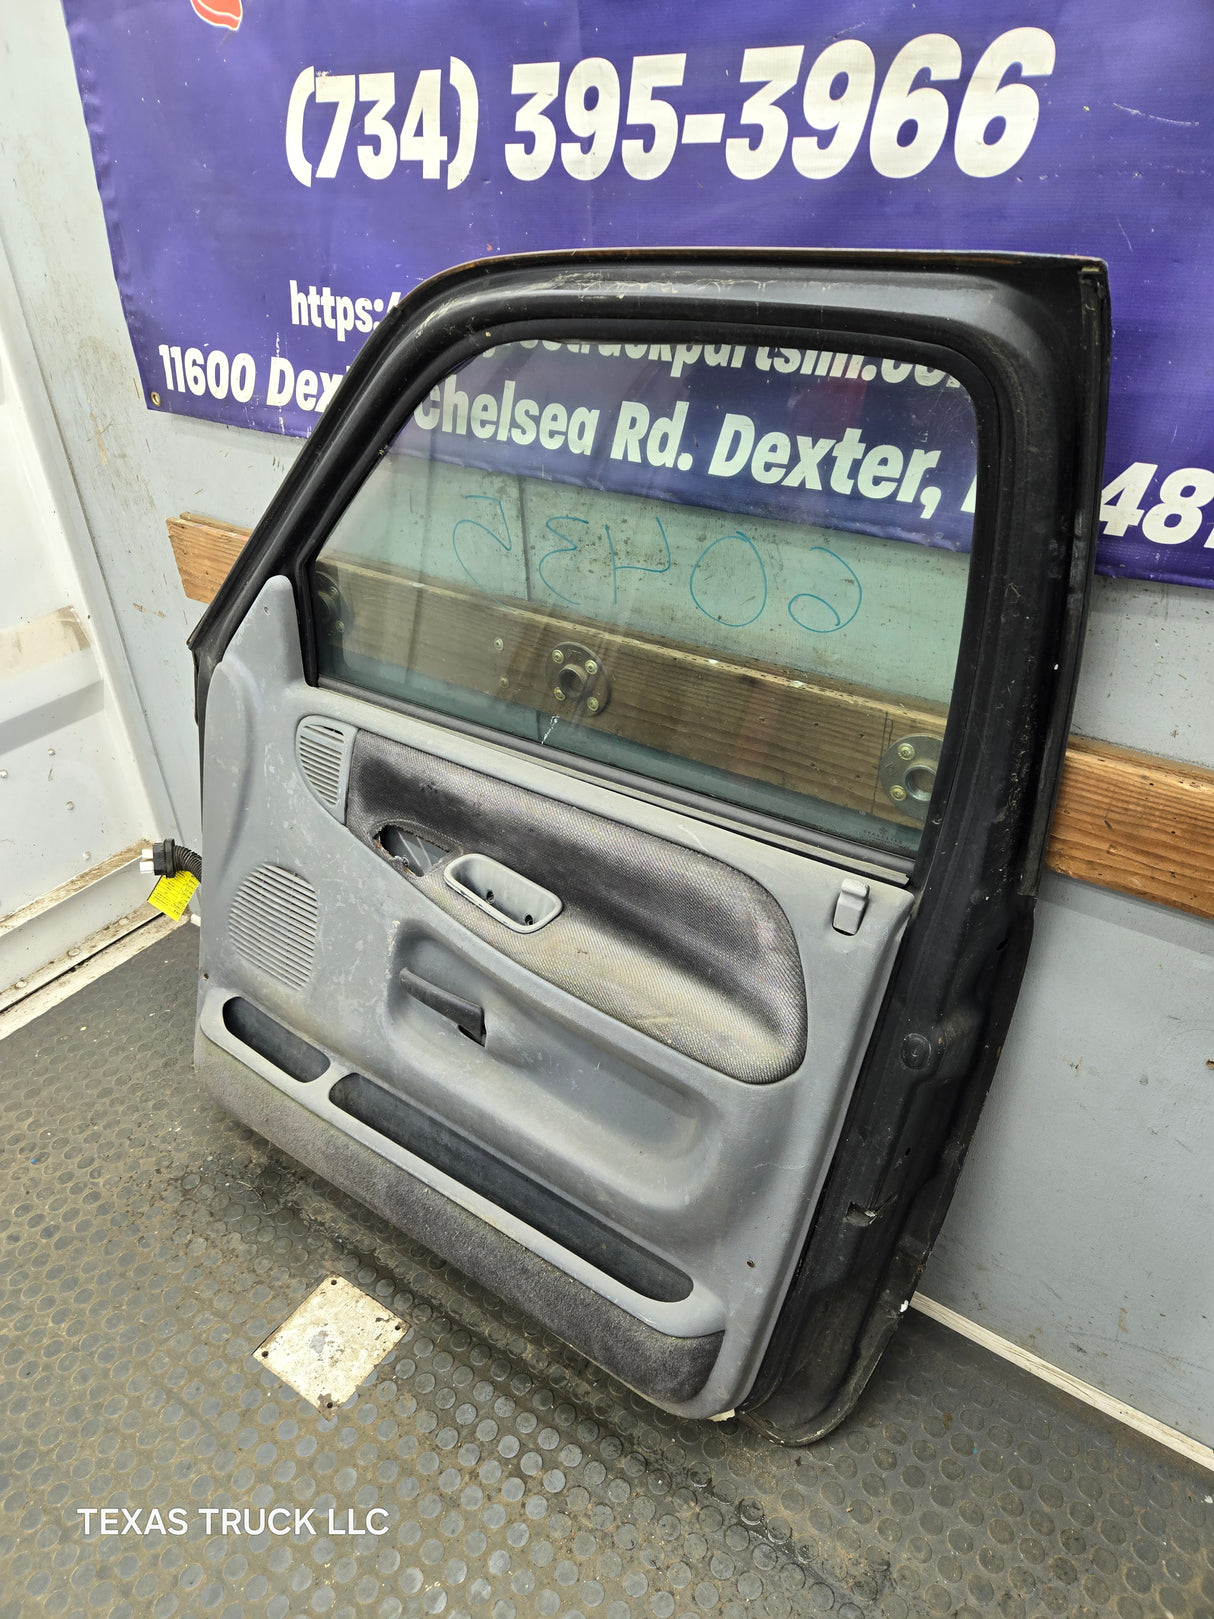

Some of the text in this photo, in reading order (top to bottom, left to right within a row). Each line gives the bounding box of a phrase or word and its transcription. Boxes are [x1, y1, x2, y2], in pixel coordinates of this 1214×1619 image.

[285, 26, 1056, 190] (734) 395-3966
[158, 344, 256, 403] 11600
[266, 356, 351, 413] Dex
[610, 401, 693, 471] Rd.
[708, 413, 942, 520] Dexter,
[1099, 461, 1214, 549] 48
